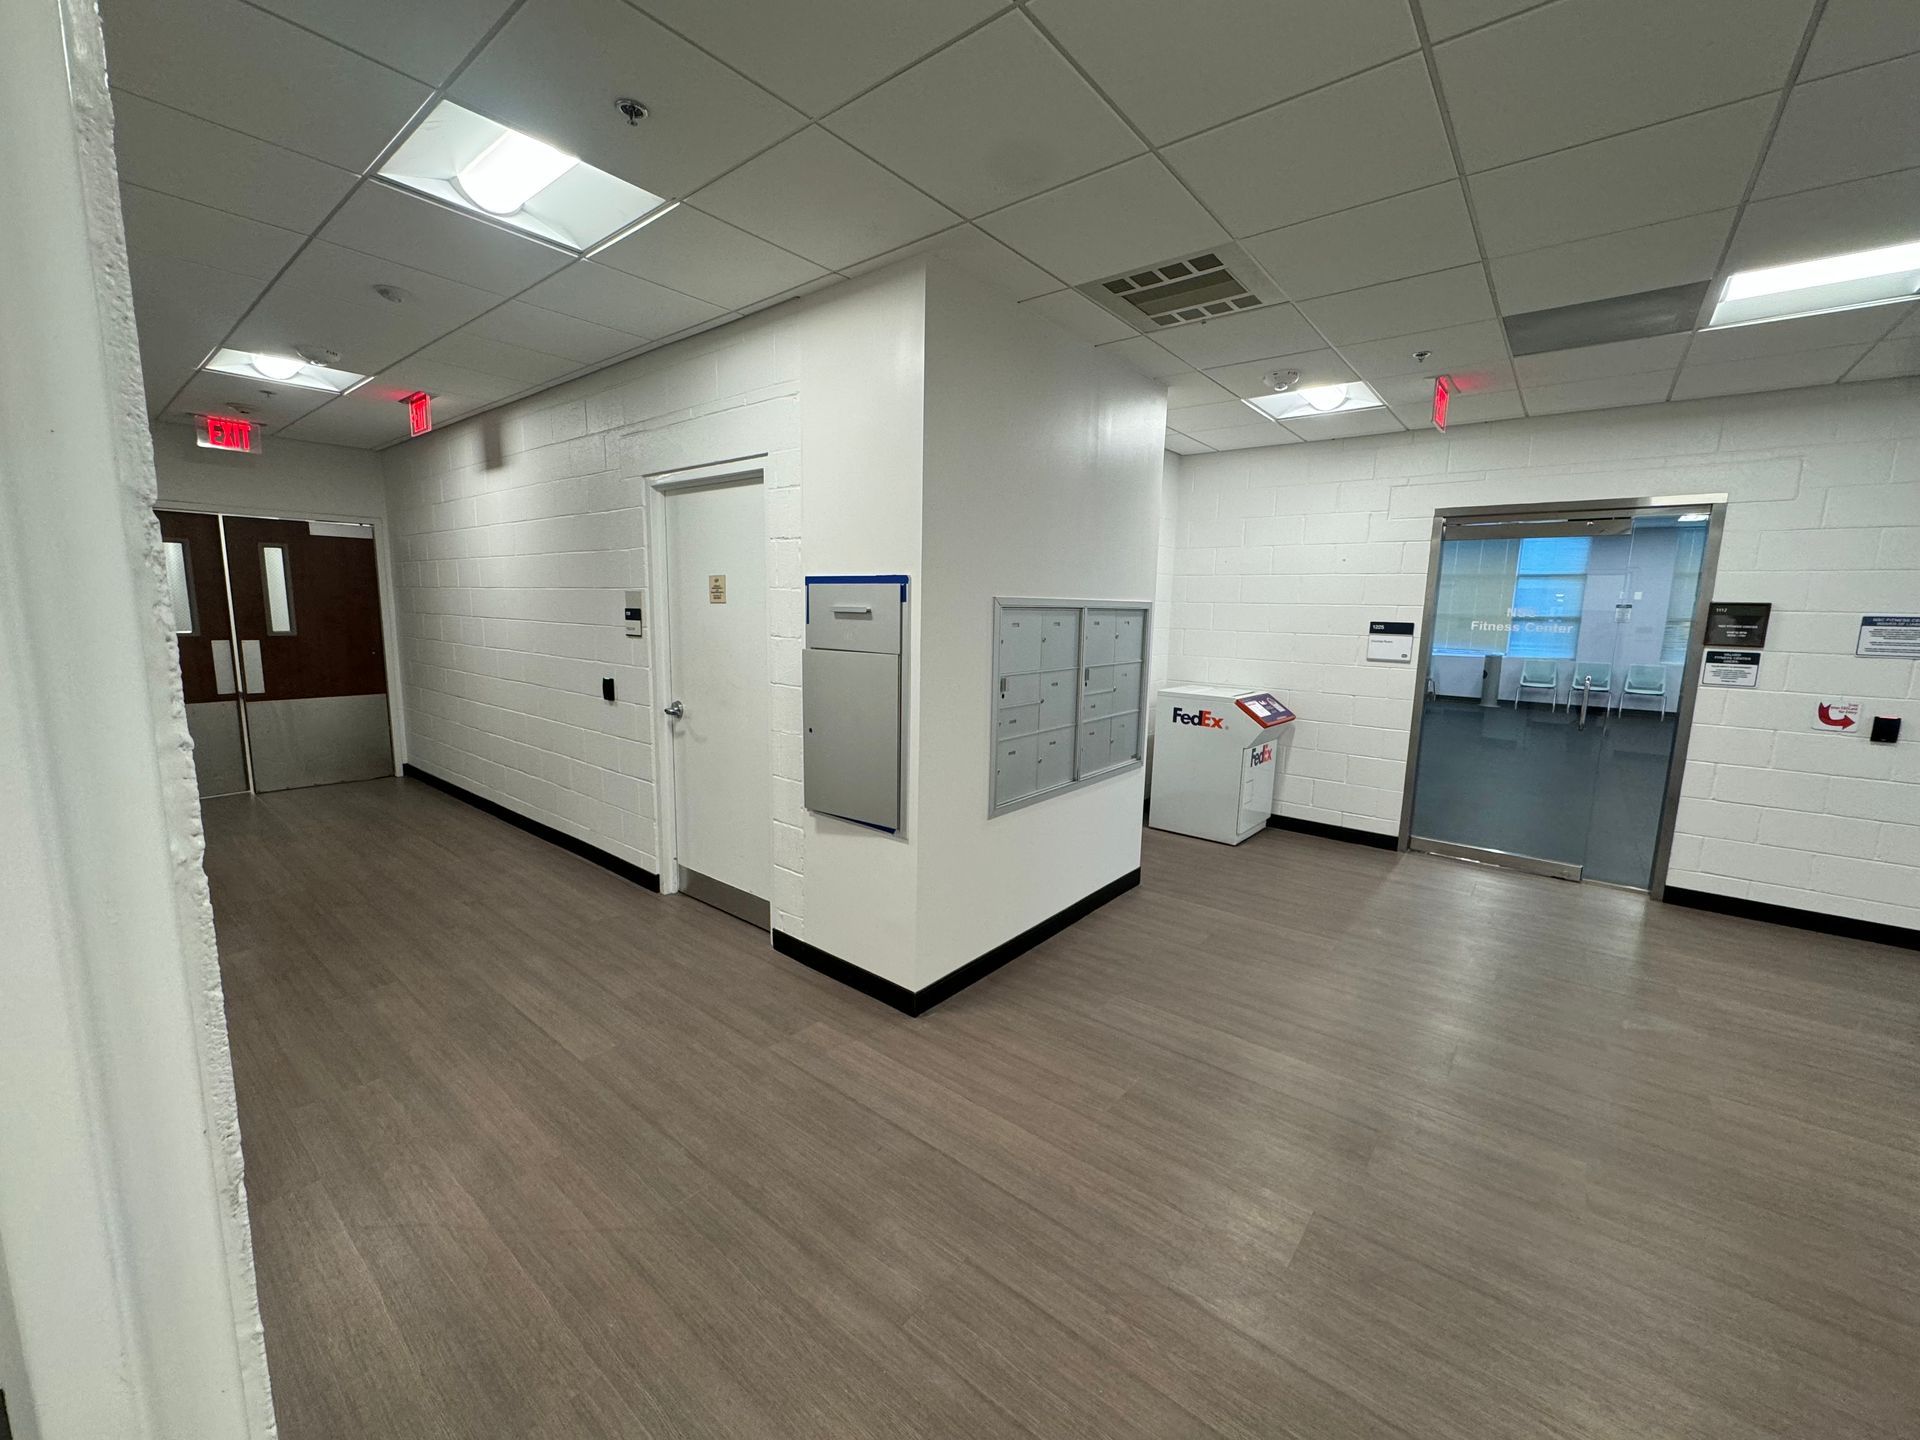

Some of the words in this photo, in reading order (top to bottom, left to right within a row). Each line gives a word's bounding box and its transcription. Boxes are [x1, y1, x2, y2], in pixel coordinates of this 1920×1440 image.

[207, 418, 252, 452] EXIT
[1470, 620, 1521, 632] Fitness
[1525, 622, 1574, 634] Center
[1172, 707, 1223, 729] FedEx
[1250, 744, 1272, 767] FedEx
